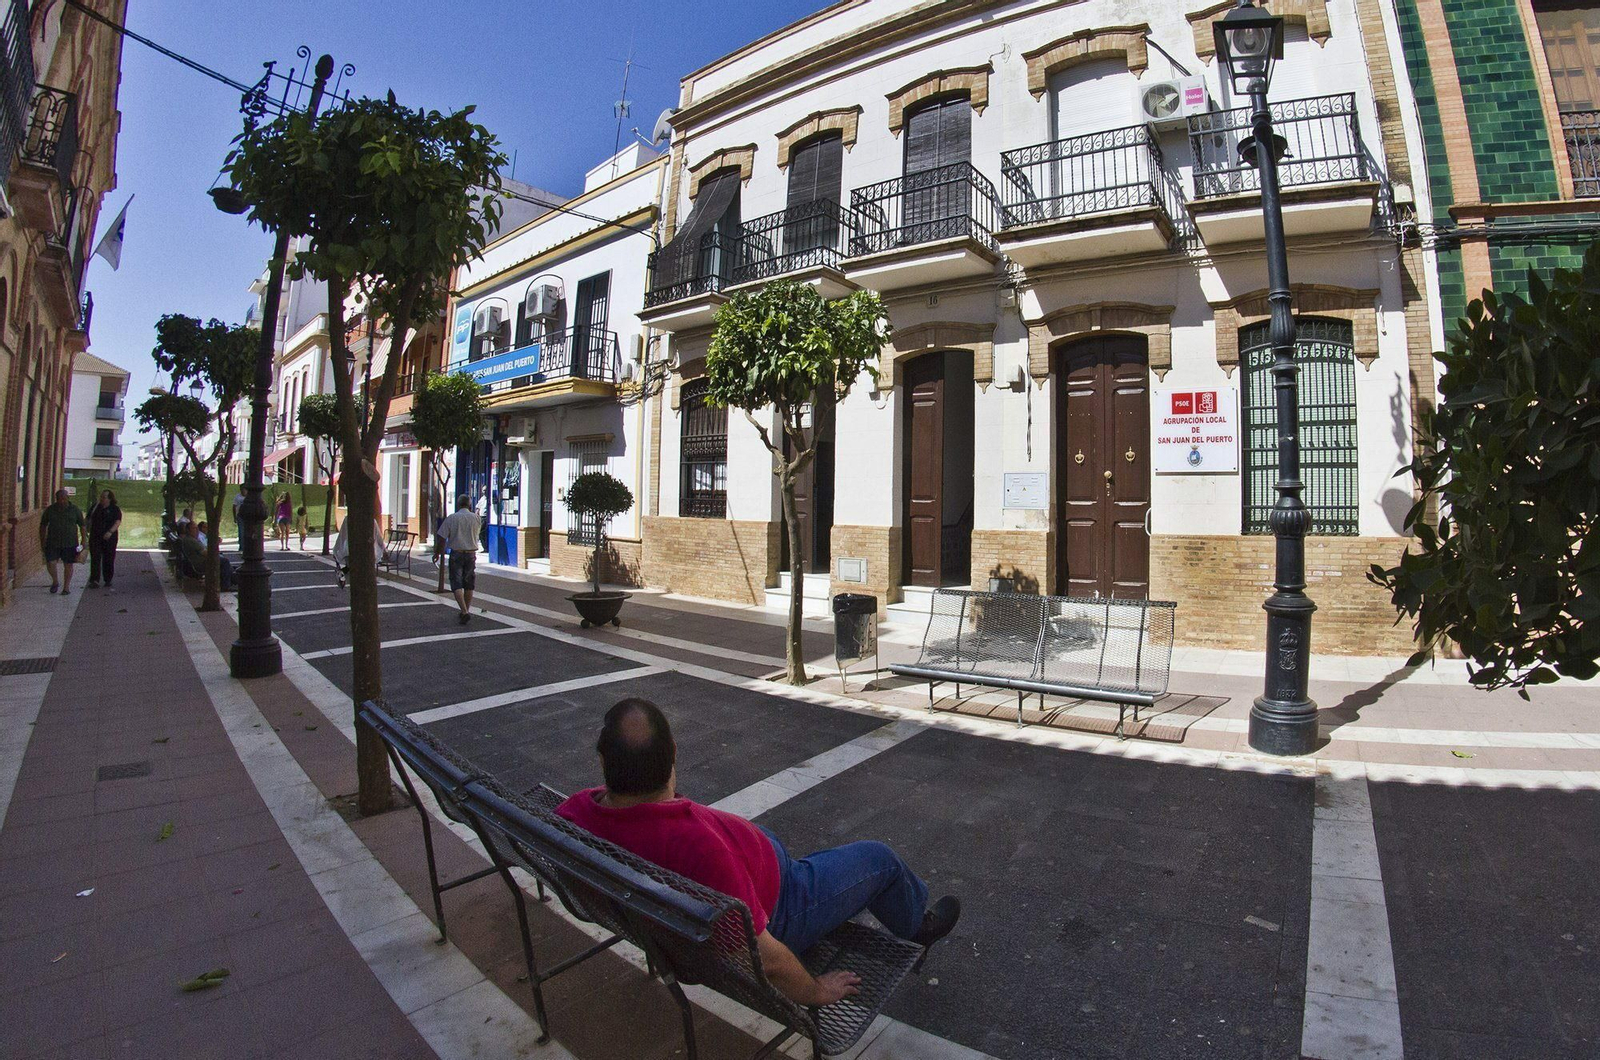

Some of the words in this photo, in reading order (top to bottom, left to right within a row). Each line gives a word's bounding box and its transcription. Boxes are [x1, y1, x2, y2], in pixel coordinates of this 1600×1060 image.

[929, 295, 938, 305] 16
[483, 367, 493, 377] SAN
[493, 363, 505, 374] JUAN
[505, 361, 514, 371] DEL
[515, 355, 535, 369] PUERTO
[1163, 416, 1204, 425] AGRUPACIÓN
[1191, 426, 1200, 434] DE
[1172, 436, 1190, 444] JUAN
[1206, 435, 1233, 443] PUERTO
